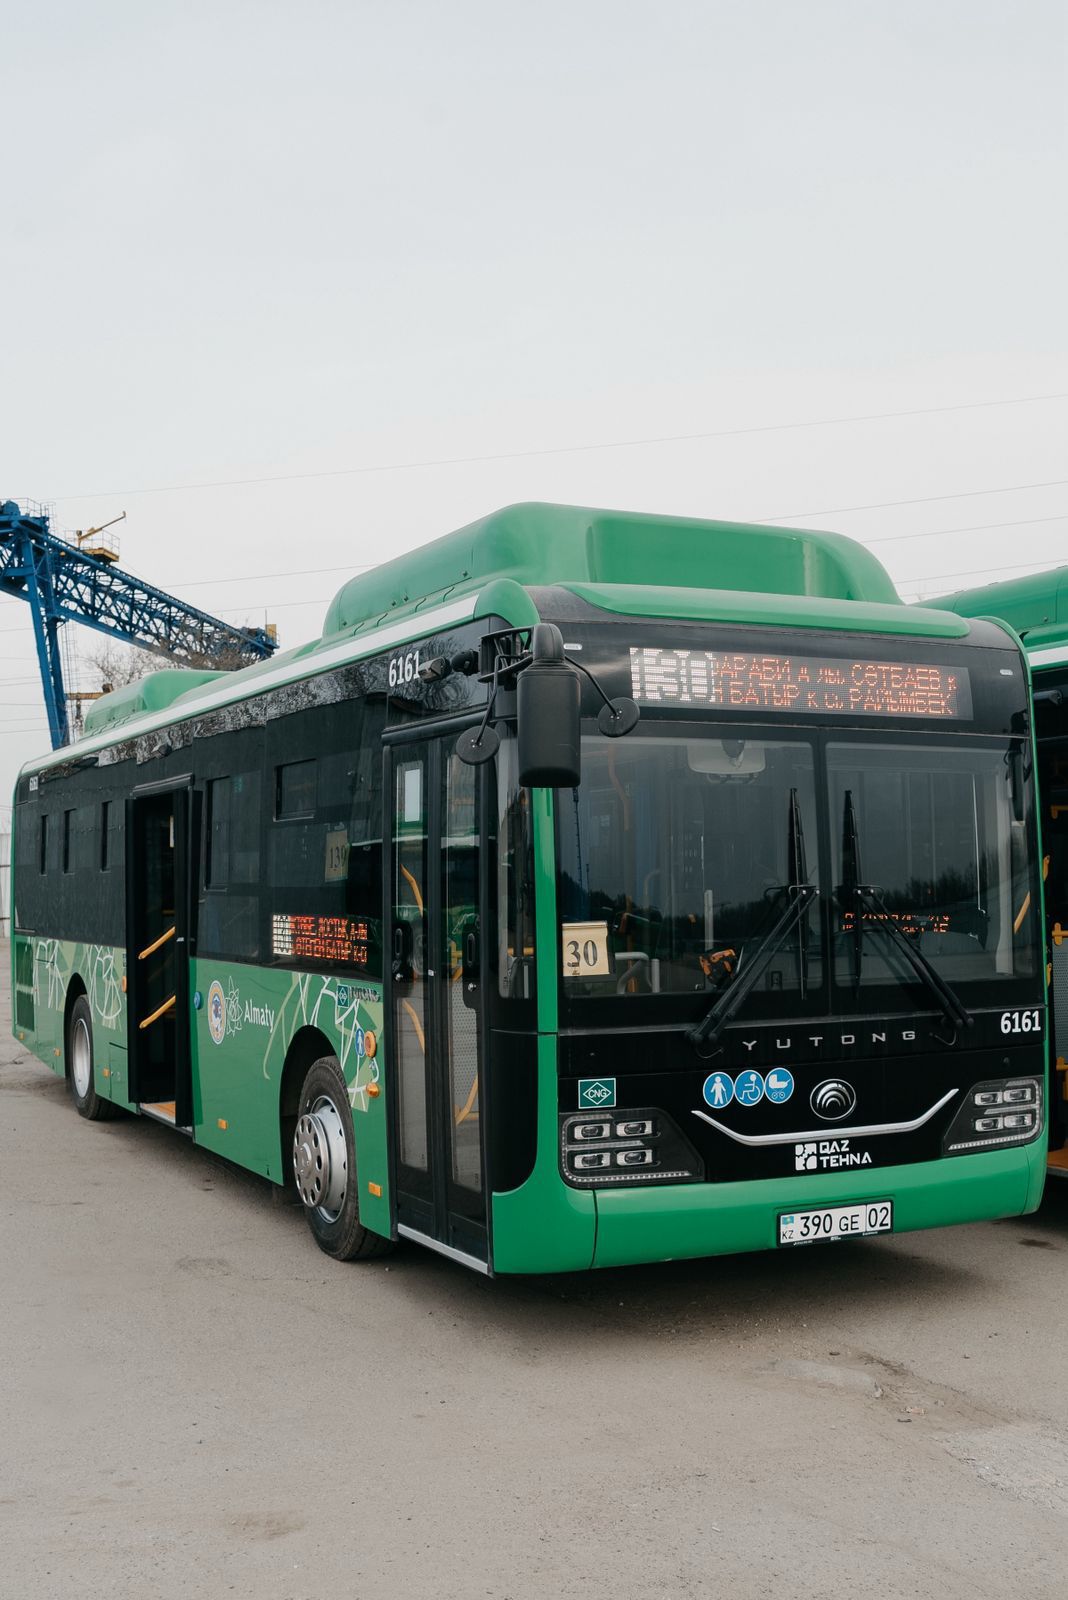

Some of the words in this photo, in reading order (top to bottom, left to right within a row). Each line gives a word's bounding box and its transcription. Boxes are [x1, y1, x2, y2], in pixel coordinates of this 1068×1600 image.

[389, 650, 420, 687] 6161
[243, 998, 275, 1033] Almaty
[1000, 1010, 1041, 1034] 6161
[742, 1031, 916, 1051] YUTONG
[588, 1088, 607, 1099] CNG
[819, 1139, 850, 1154] QAZ
[819, 1151, 872, 1168] TEHNA
[799, 1213, 832, 1237] 390
[839, 1214, 860, 1232] GE
[868, 1206, 889, 1228] 02
[782, 1230, 794, 1240] KZ
